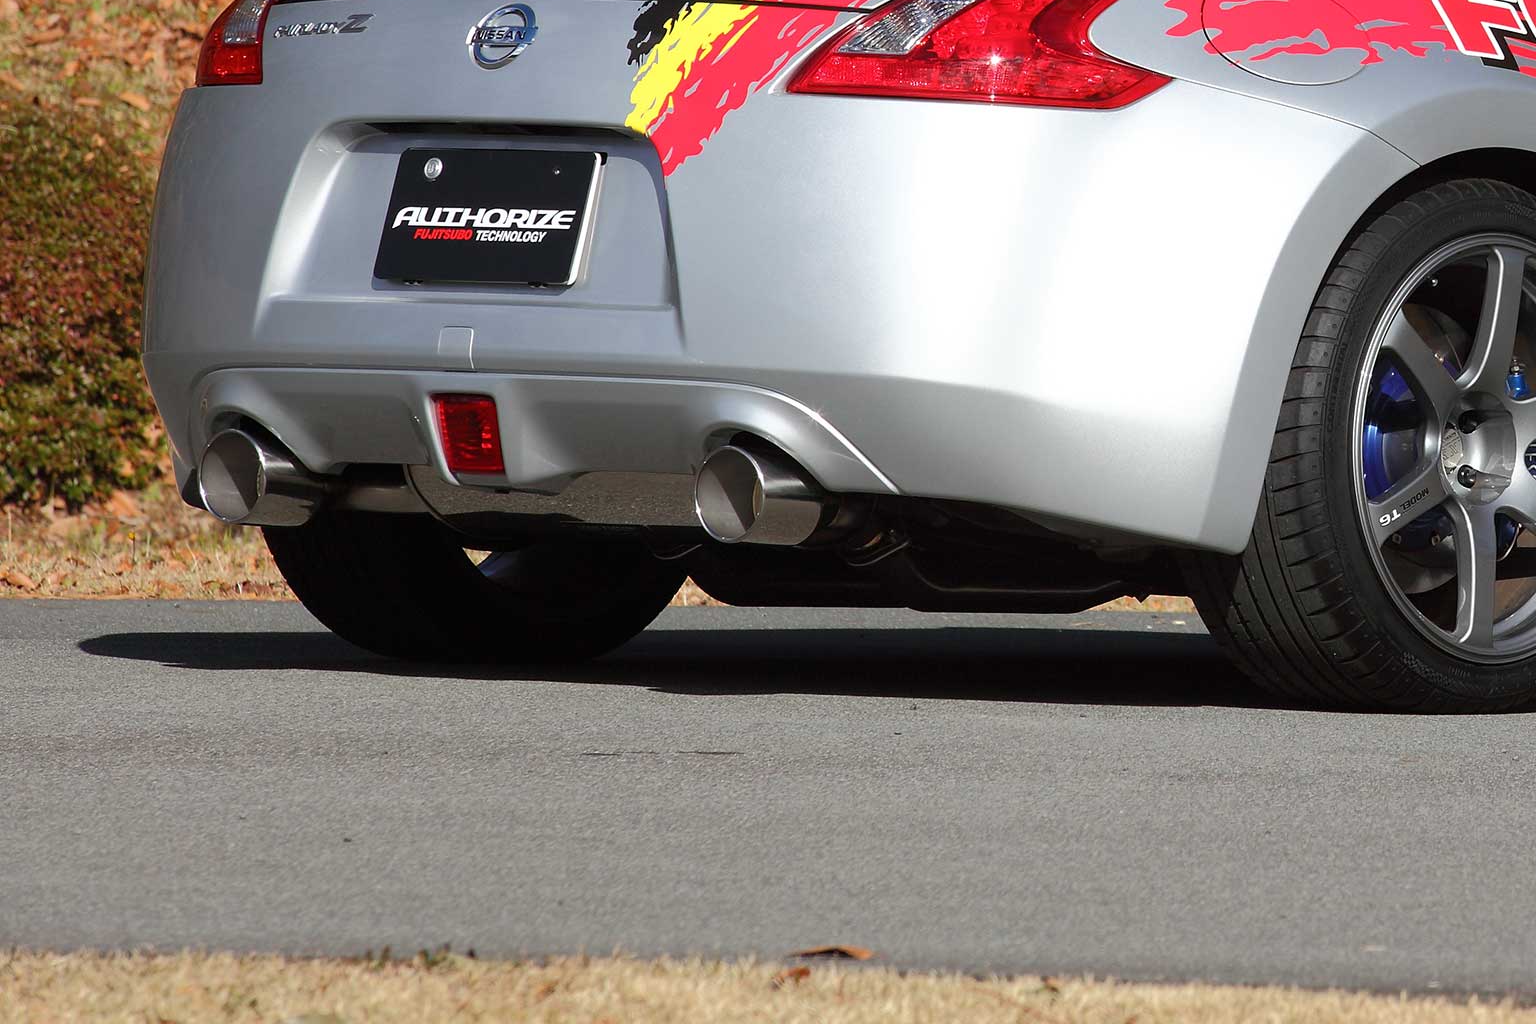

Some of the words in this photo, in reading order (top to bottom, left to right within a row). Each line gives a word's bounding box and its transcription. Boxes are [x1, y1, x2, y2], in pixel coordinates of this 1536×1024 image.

[474, 28, 527, 41] NISSAN
[392, 206, 577, 230] AUTHORIZE
[413, 228, 473, 241] FUJITSUBO
[475, 229, 548, 243] TECHNOLOGY
[1400, 487, 1430, 511] MODEL
[1379, 508, 1402, 527] T6
